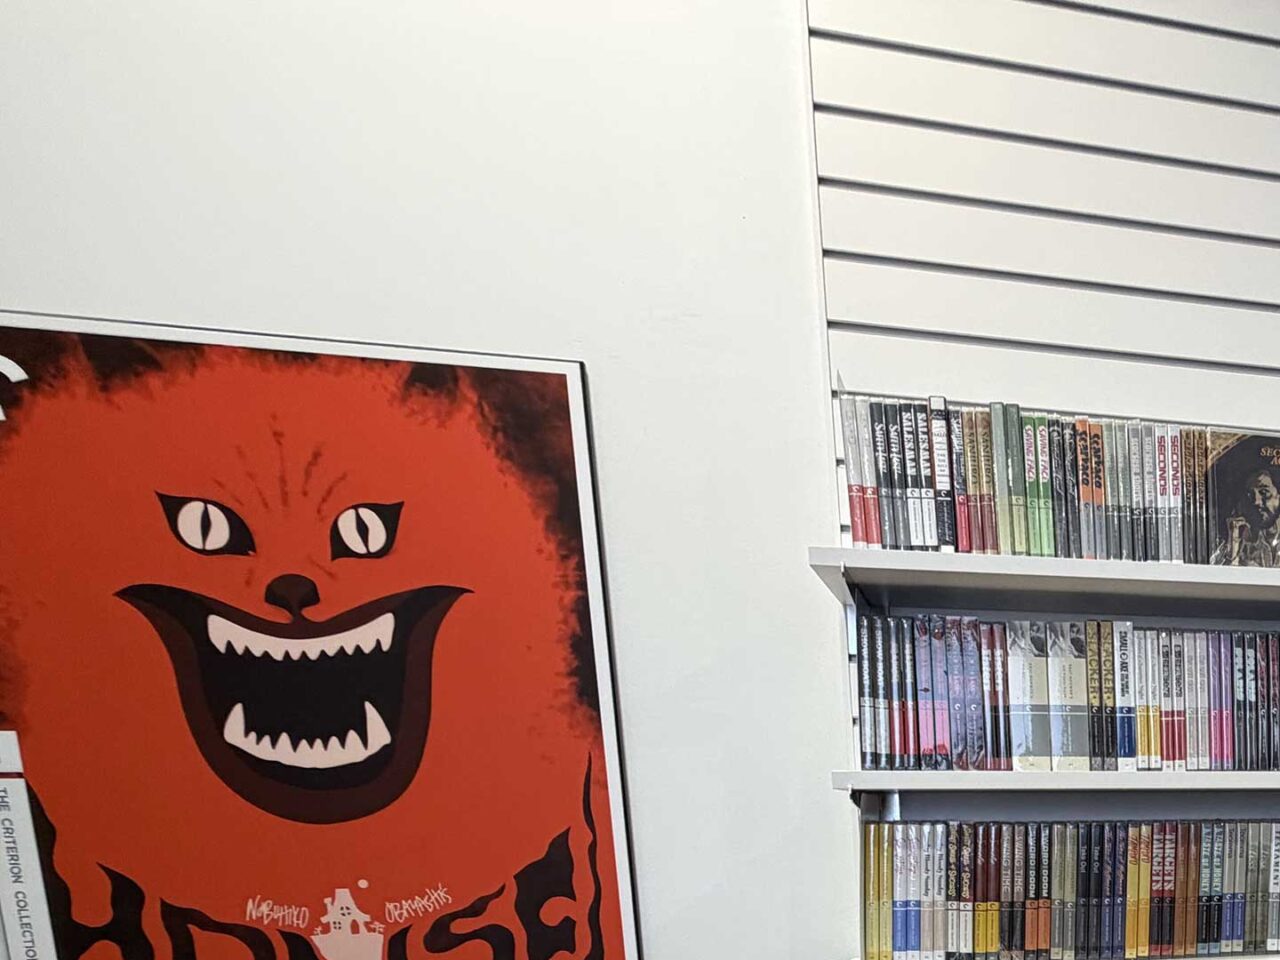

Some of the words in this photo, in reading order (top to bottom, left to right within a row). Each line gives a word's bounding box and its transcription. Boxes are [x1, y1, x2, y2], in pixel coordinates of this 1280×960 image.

[1158, 435, 1168, 496] SECONDS
[1171, 435, 1181, 496] SECONDS
[1, 818, 24, 884] CRITERION
[1152, 834, 1163, 890] TARGETS
[1165, 834, 1175, 890] TARGETS
